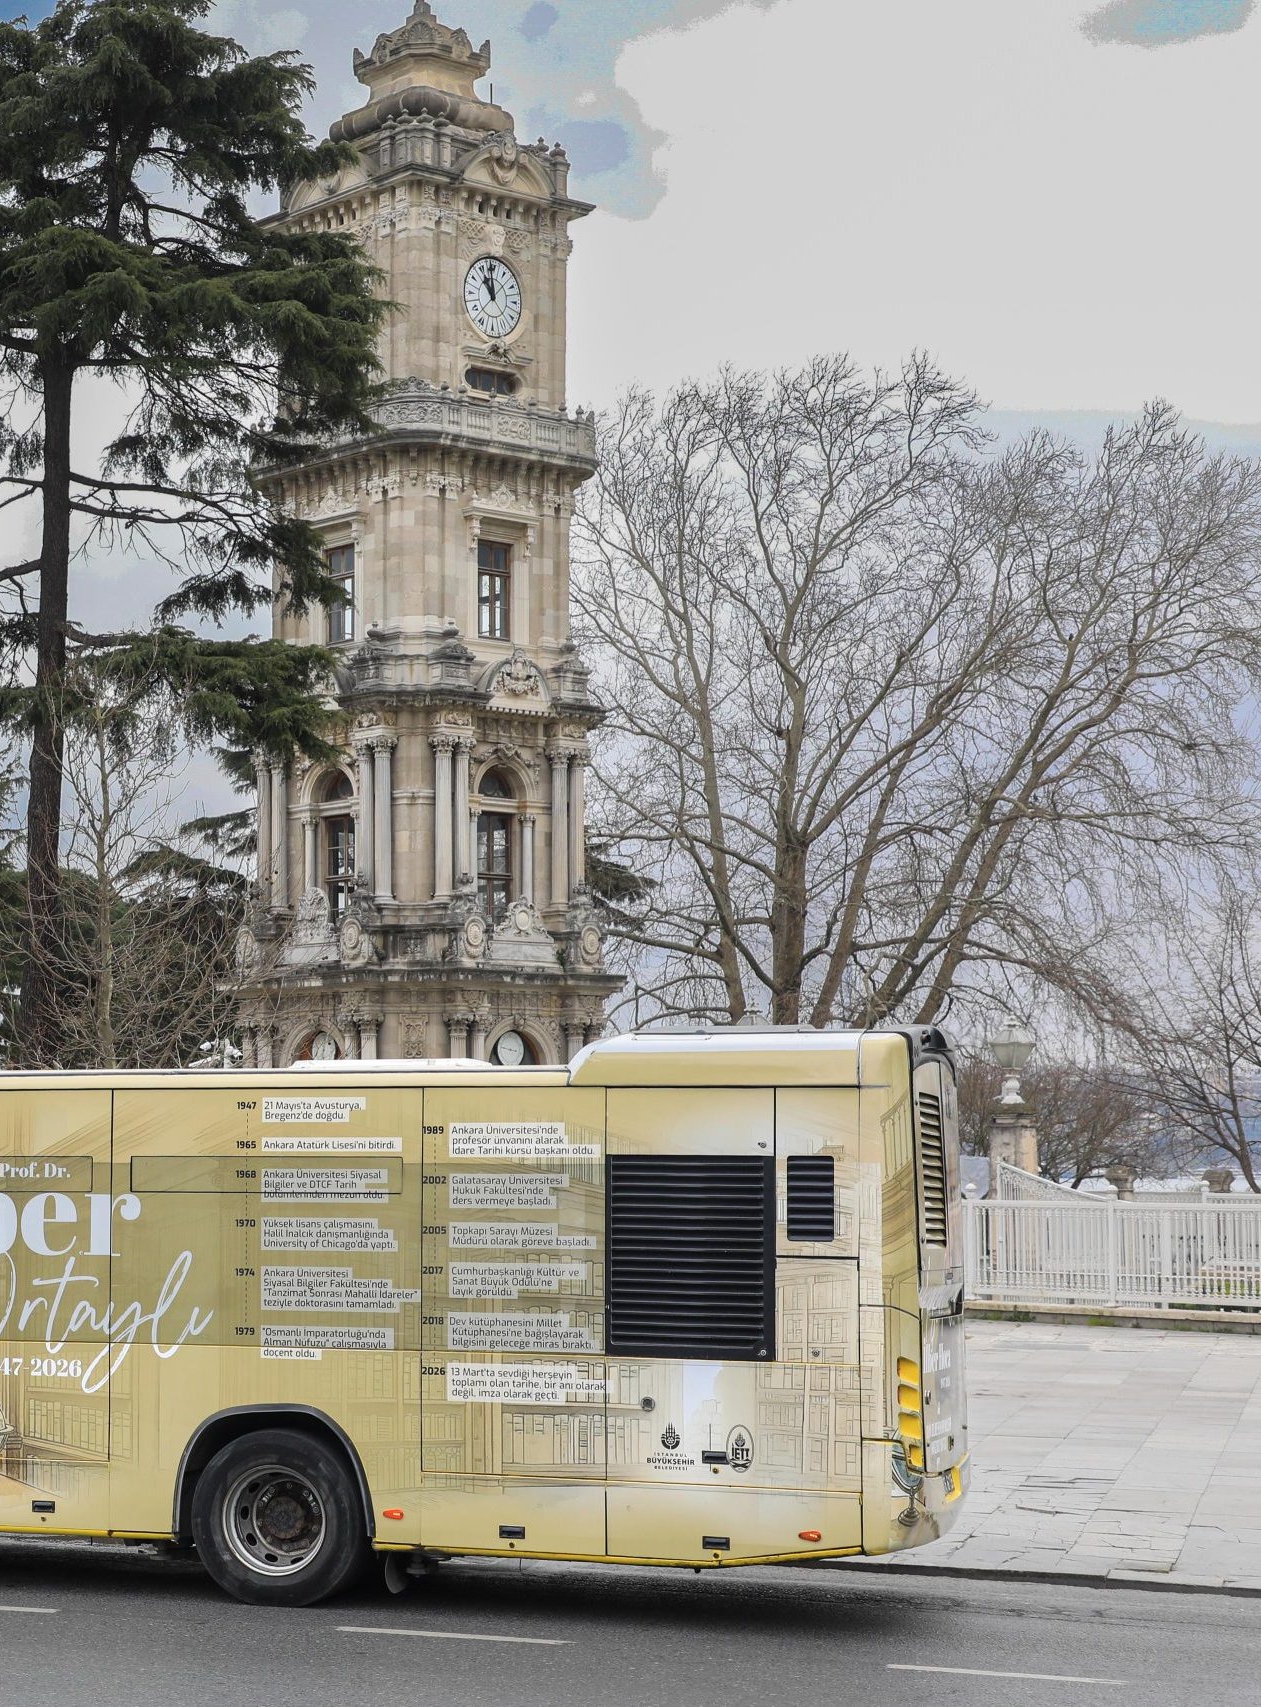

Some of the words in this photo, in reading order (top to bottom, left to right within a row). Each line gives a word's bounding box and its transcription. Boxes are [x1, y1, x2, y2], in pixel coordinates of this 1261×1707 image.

[237, 1102, 257, 1110] 1947
[264, 1101, 273, 1110] 21
[314, 1101, 362, 1111] Avusturya,
[265, 1111, 313, 1122] Bregenz'de
[315, 1111, 346, 1122] doğdu.
[422, 1126, 444, 1134] 1989
[451, 1126, 484, 1135] Ankara
[486, 1124, 559, 1135] Üniversitesi'nde
[236, 1141, 257, 1149] 1965
[452, 1136, 491, 1146] profesör
[535, 1135, 564, 1145] alarak
[263, 1141, 294, 1150] Ankara
[296, 1141, 330, 1150] Atatürk
[332, 1141, 366, 1150] Lisesi'ni
[368, 1141, 396, 1150] bitirdi.
[478, 1146, 503, 1155] Tarihi
[505, 1146, 531, 1155] kürsü
[572, 1146, 595, 1155] oldu.
[0, 1162, 40, 1179] Prof.
[44, 1162, 71, 1179] Dr.
[235, 1170, 257, 1178] 1968
[263, 1170, 294, 1179] Ankara
[296, 1168, 348, 1179] Üniversitesi
[350, 1170, 381, 1181] Siyasal
[422, 1176, 447, 1184] 2002
[451, 1176, 506, 1187] Galatasaray
[509, 1174, 563, 1185] Üniversitesi
[264, 1180, 294, 1191] Bilgiler
[309, 1181, 332, 1189] DTCF
[335, 1181, 357, 1189] Tarih
[452, 1186, 481, 1195] Hukuk
[452, 1196, 473, 1205] ders
[475, 1198, 515, 1207] vermeye
[235, 1219, 256, 1227] 1970
[296, 1220, 321, 1228] lisans
[264, 1230, 283, 1238] Halil
[422, 1226, 446, 1234] 2005
[452, 1226, 487, 1236] Topkapı
[520, 1227, 553, 1236] Müzesi
[263, 1239, 308, 1249] University
[310, 1239, 320, 1248] of
[321, 1240, 369, 1250] Chicago'da
[490, 1236, 519, 1246] olarak
[521, 1238, 553, 1248] göreve
[235, 1268, 255, 1276] 1974
[263, 1268, 295, 1277] Ankara
[422, 1266, 444, 1275] 2017
[537, 1268, 566, 1277] Kültür
[263, 1279, 294, 1289] Siyasal
[297, 1279, 328, 1290] Bilgiler
[452, 1277, 478, 1285] Sanat
[263, 1299, 292, 1309] teziyle
[422, 1317, 444, 1325] 2018
[449, 1317, 467, 1325] Dev
[536, 1319, 562, 1327] Millet
[235, 1327, 255, 1335] 1979
[452, 1338, 487, 1348] bilgisini
[533, 1340, 560, 1349] miras
[263, 1348, 293, 1358] doçent
[295, 1349, 317, 1358] oldu.
[422, 1367, 445, 1375] 2026
[451, 1367, 460, 1376] 13
[462, 1368, 495, 1377] Mart'ta
[532, 1370, 572, 1380] herşeyin
[489, 1379, 510, 1388] olan
[512, 1380, 541, 1390] tarihe,
[544, 1380, 557, 1389] bir
[575, 1382, 606, 1391] olarak
[478, 1389, 501, 1398] imza
[503, 1390, 532, 1398] olarak
[534, 1390, 559, 1401] geçti.
